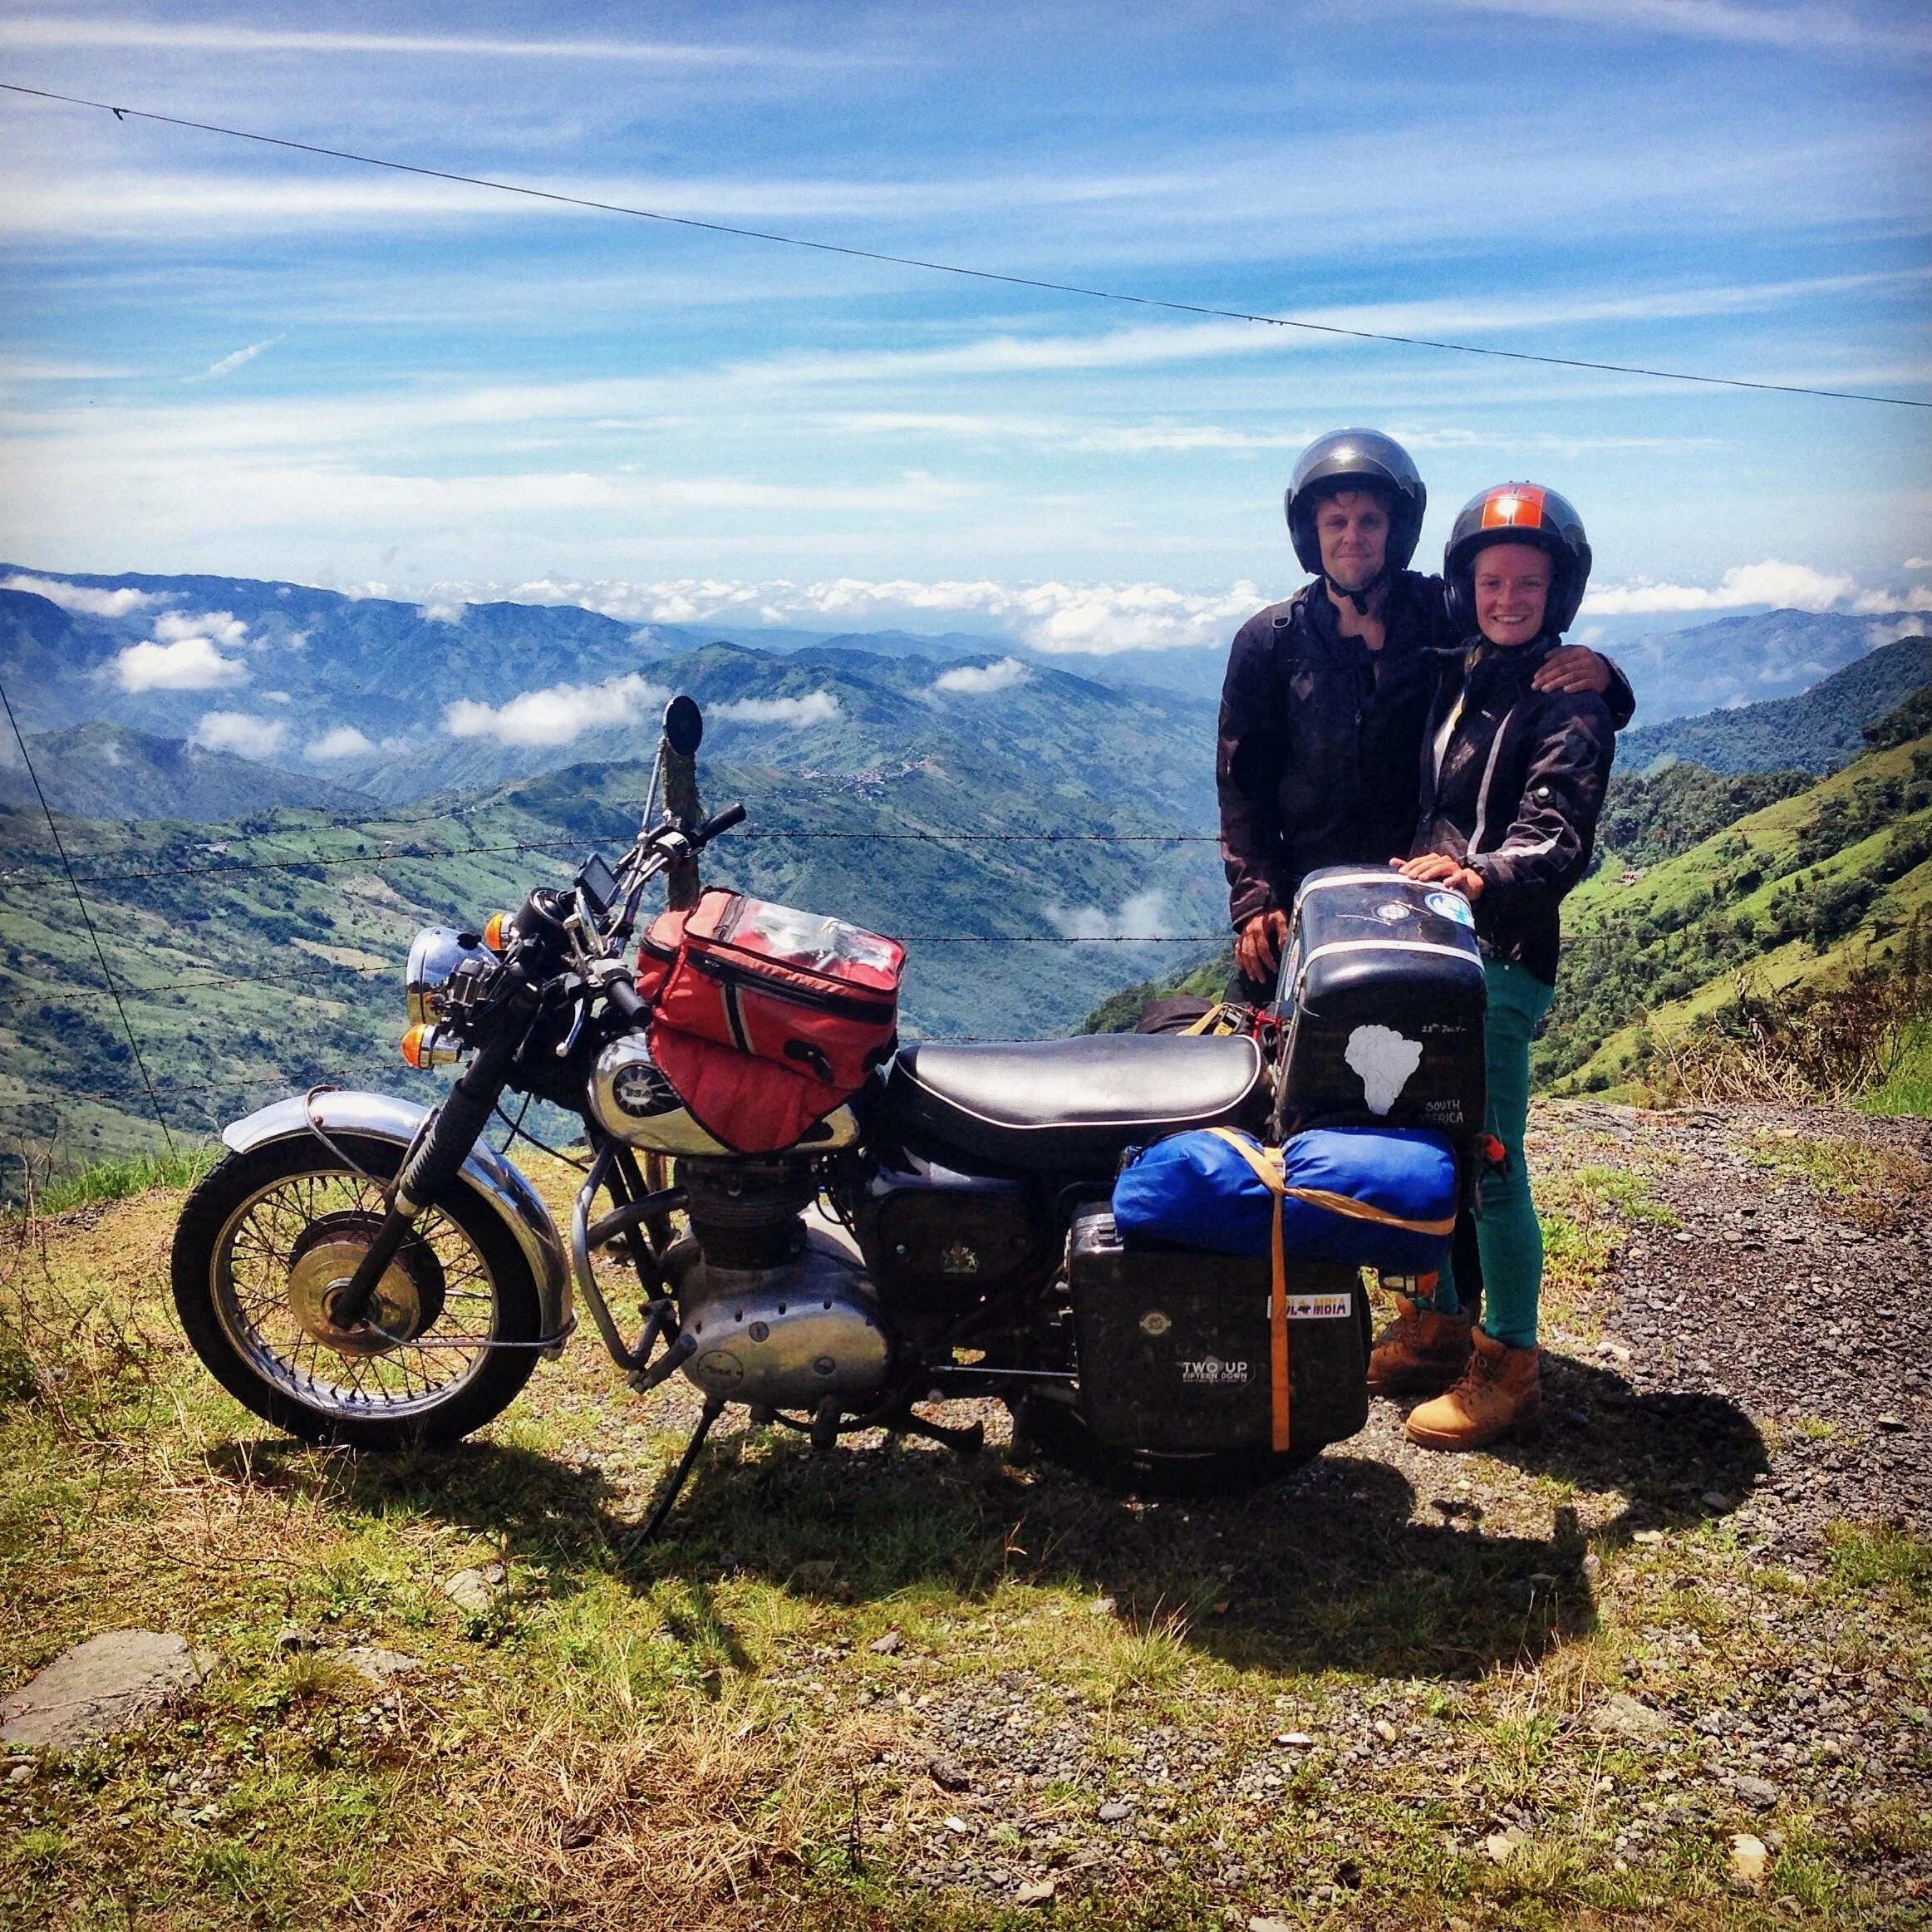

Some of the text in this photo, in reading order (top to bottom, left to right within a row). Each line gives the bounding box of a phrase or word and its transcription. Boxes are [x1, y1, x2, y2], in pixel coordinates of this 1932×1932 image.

[1425, 1099, 1460, 1112] SOUTH
[1182, 1362, 1248, 1373] TWO UP
